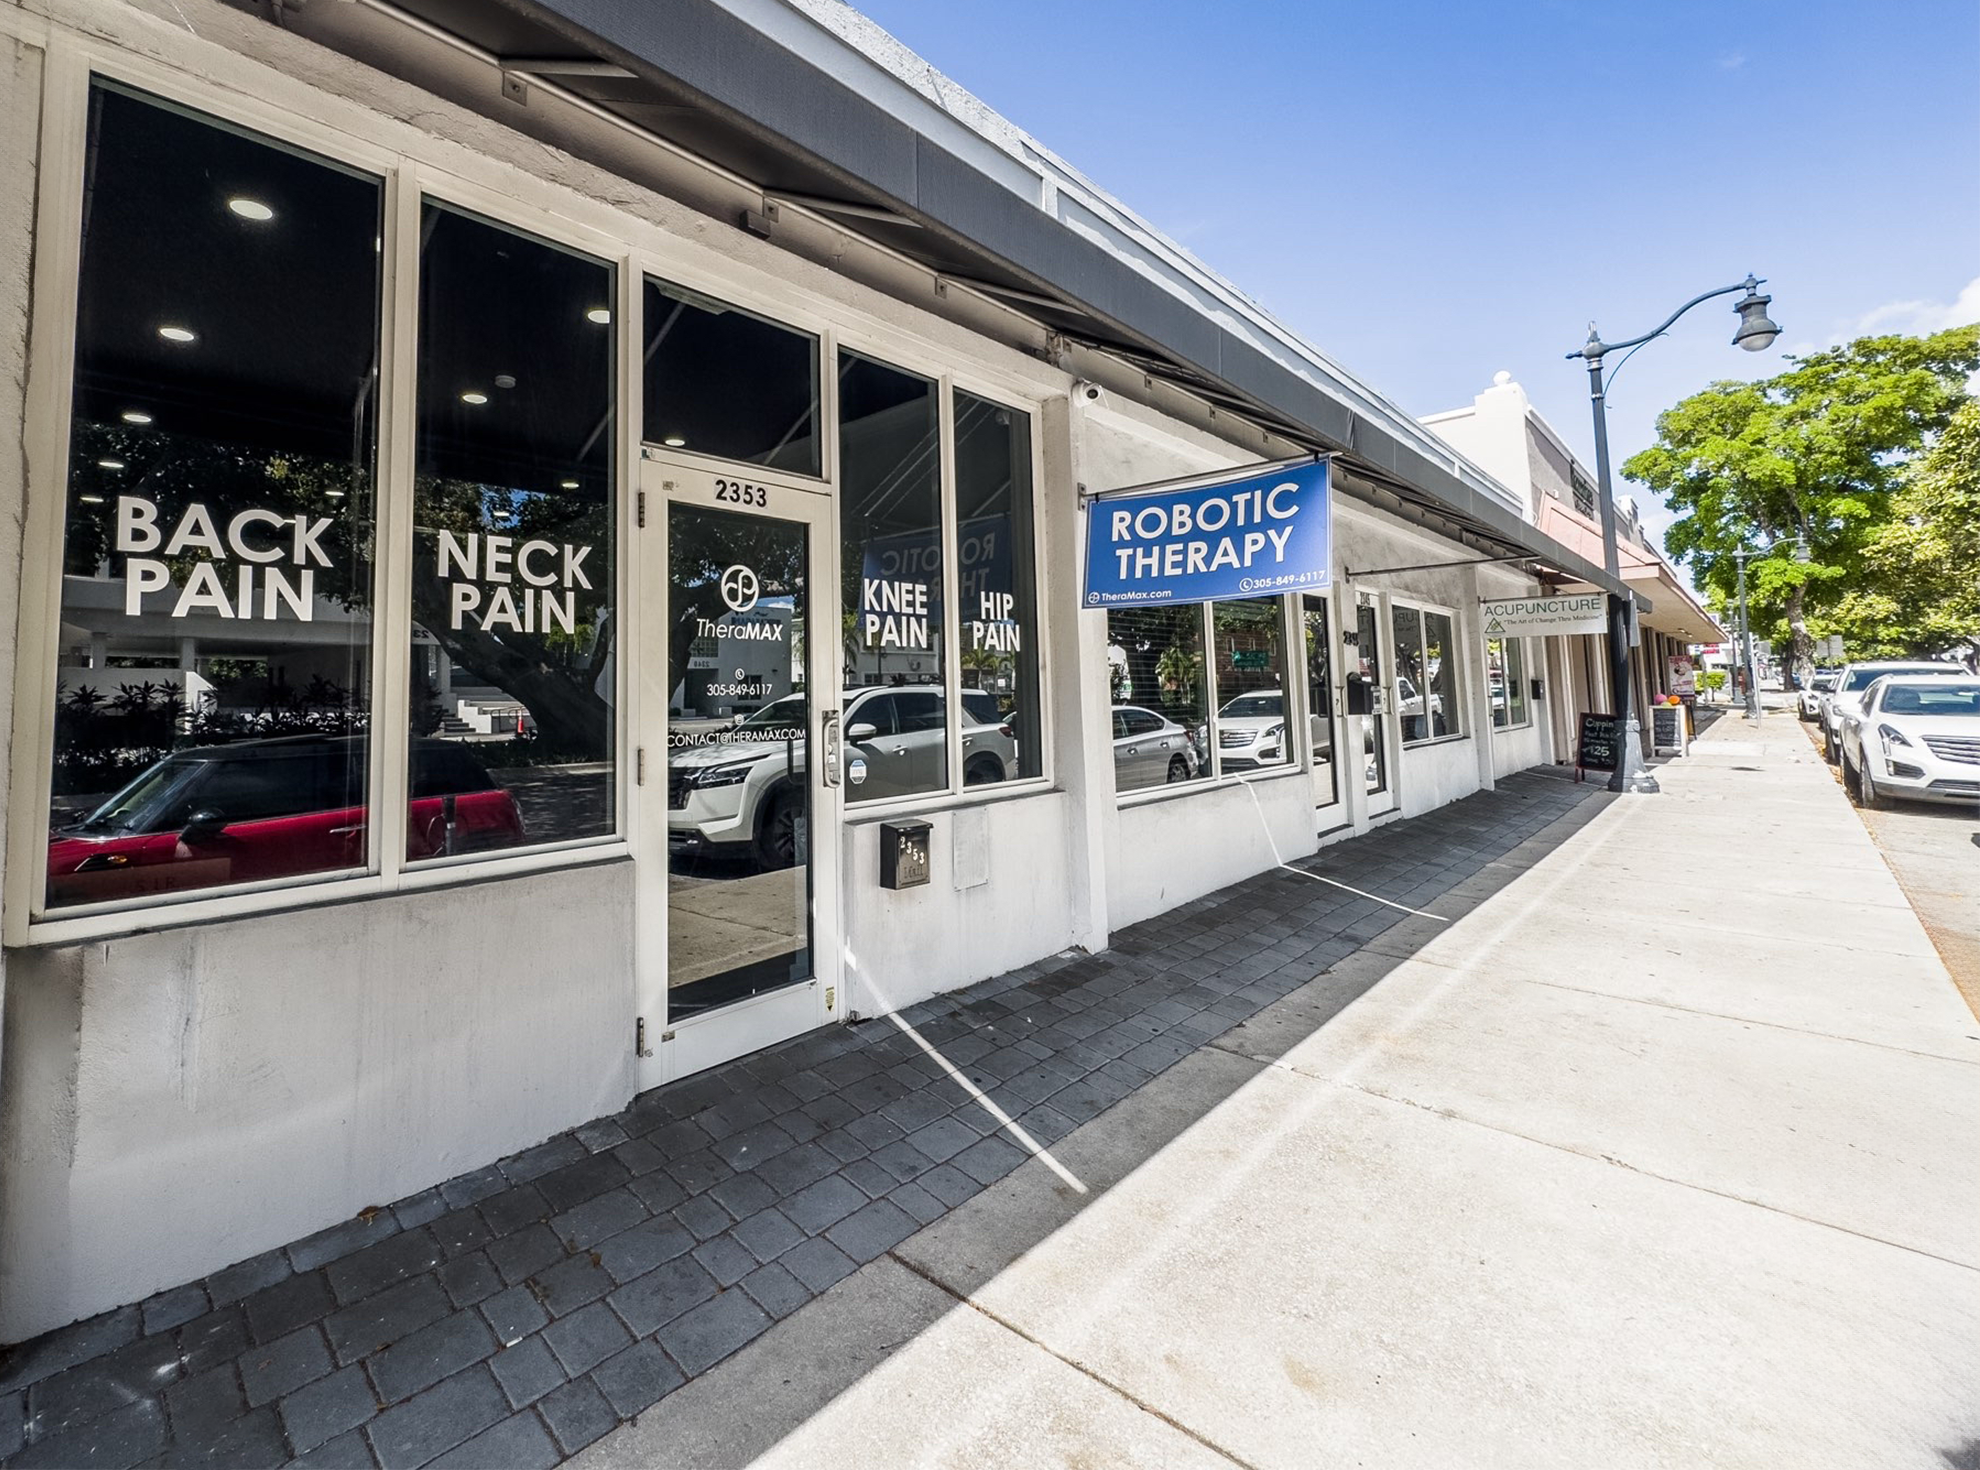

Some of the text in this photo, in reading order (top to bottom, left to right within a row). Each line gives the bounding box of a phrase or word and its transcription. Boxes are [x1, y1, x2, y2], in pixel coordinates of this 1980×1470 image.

[714, 479, 768, 508] 2353
[1111, 482, 1300, 542] ROBOTIC
[116, 495, 334, 568] BACK
[437, 528, 593, 590] NECK
[1115, 525, 1294, 580] THERAPY
[126, 557, 314, 622] PAIN
[1253, 569, 1327, 589] 305-849-6117
[451, 582, 575, 635] PAIN
[863, 578, 928, 615] KNEE
[980, 591, 1014, 621] HIP
[1101, 589, 1172, 602] TheraMax.com
[1484, 597, 1602, 617] ACUPUNCTURE
[696, 618, 784, 642] TheraMAX
[865, 614, 928, 649] PAIN
[972, 620, 1021, 652] PAIN
[706, 683, 773, 698] 305-849-6117
[666, 728, 807, 747] CONTACT@THERAMAX.COM
[1585, 718, 1615, 731] Cuppin
[900, 836, 925, 865] 2353
